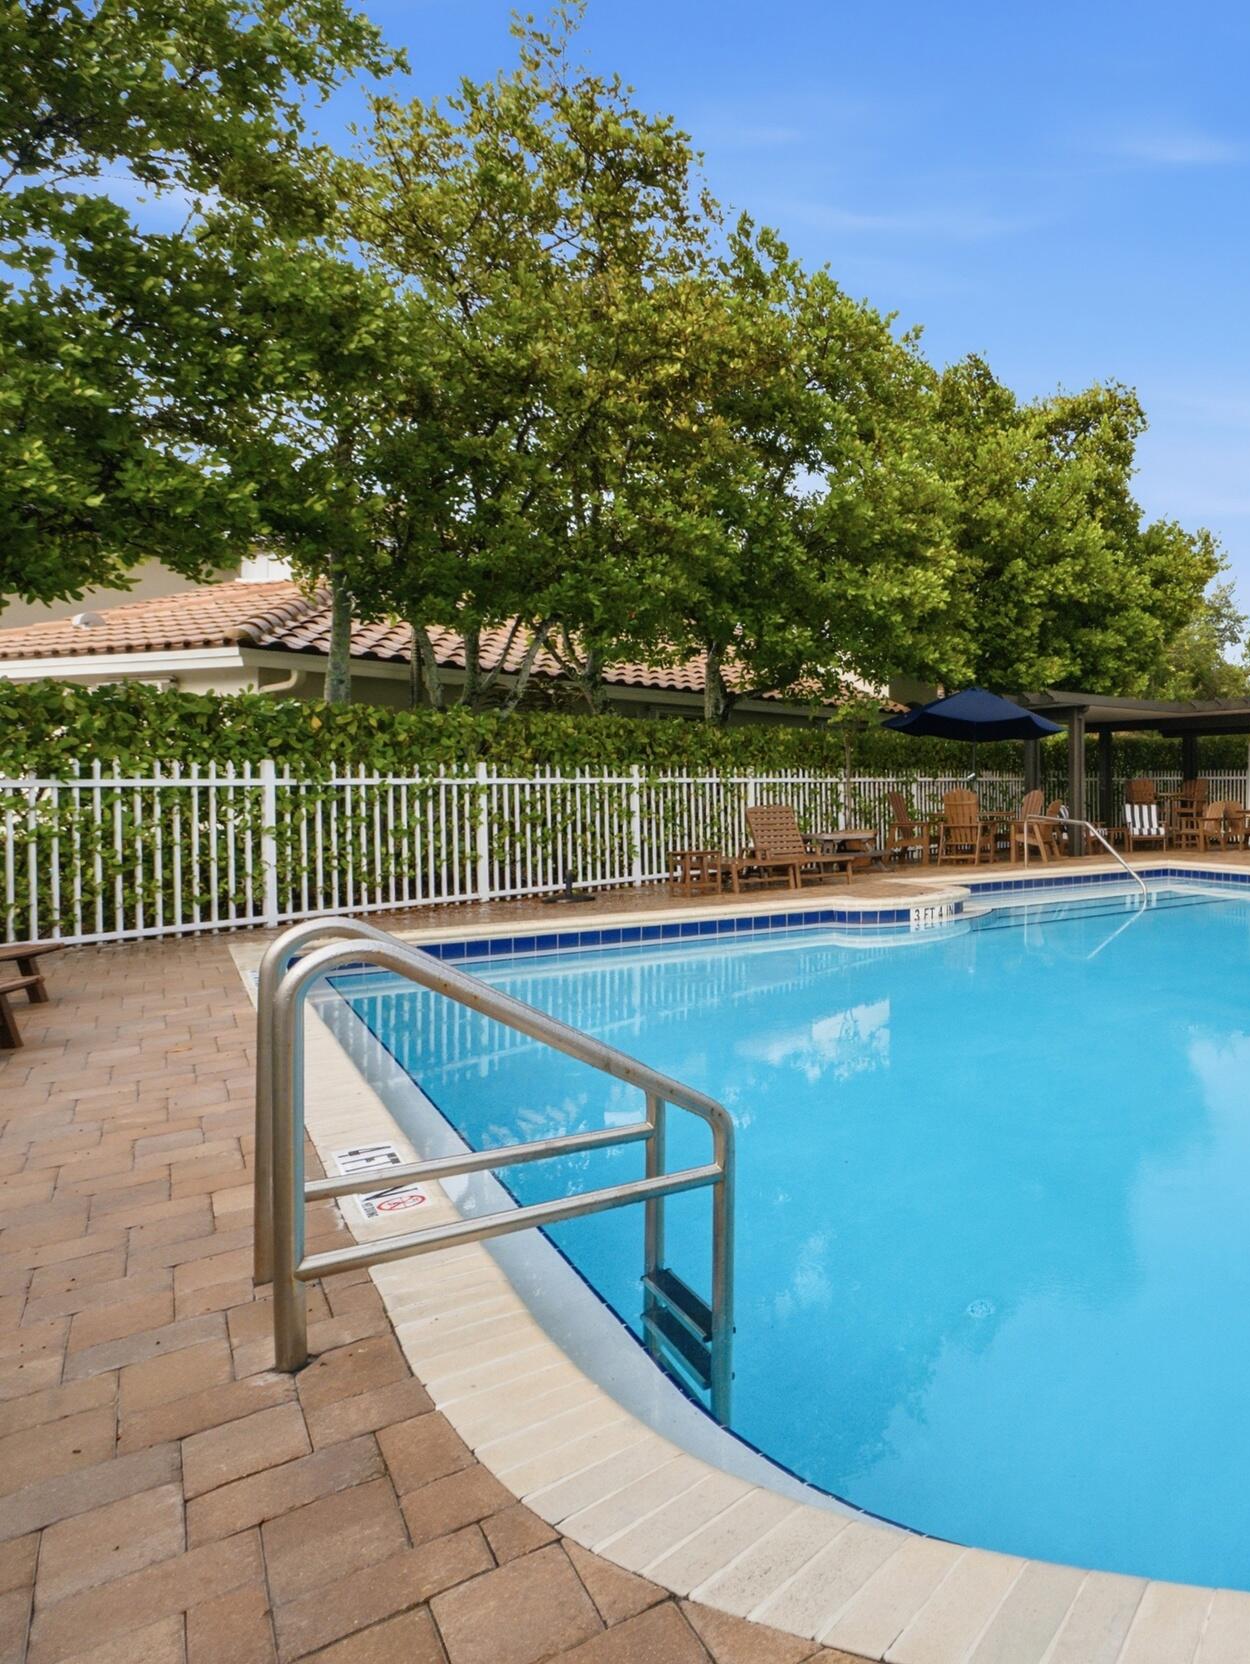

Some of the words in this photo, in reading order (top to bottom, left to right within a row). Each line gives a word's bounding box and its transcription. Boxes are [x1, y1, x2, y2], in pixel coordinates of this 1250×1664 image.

[914, 908, 920, 921] 3
[924, 907, 935, 920] FT
[946, 904, 954, 917] IN
[338, 1145, 392, 1159] 4
[341, 1152, 401, 1173] FT
